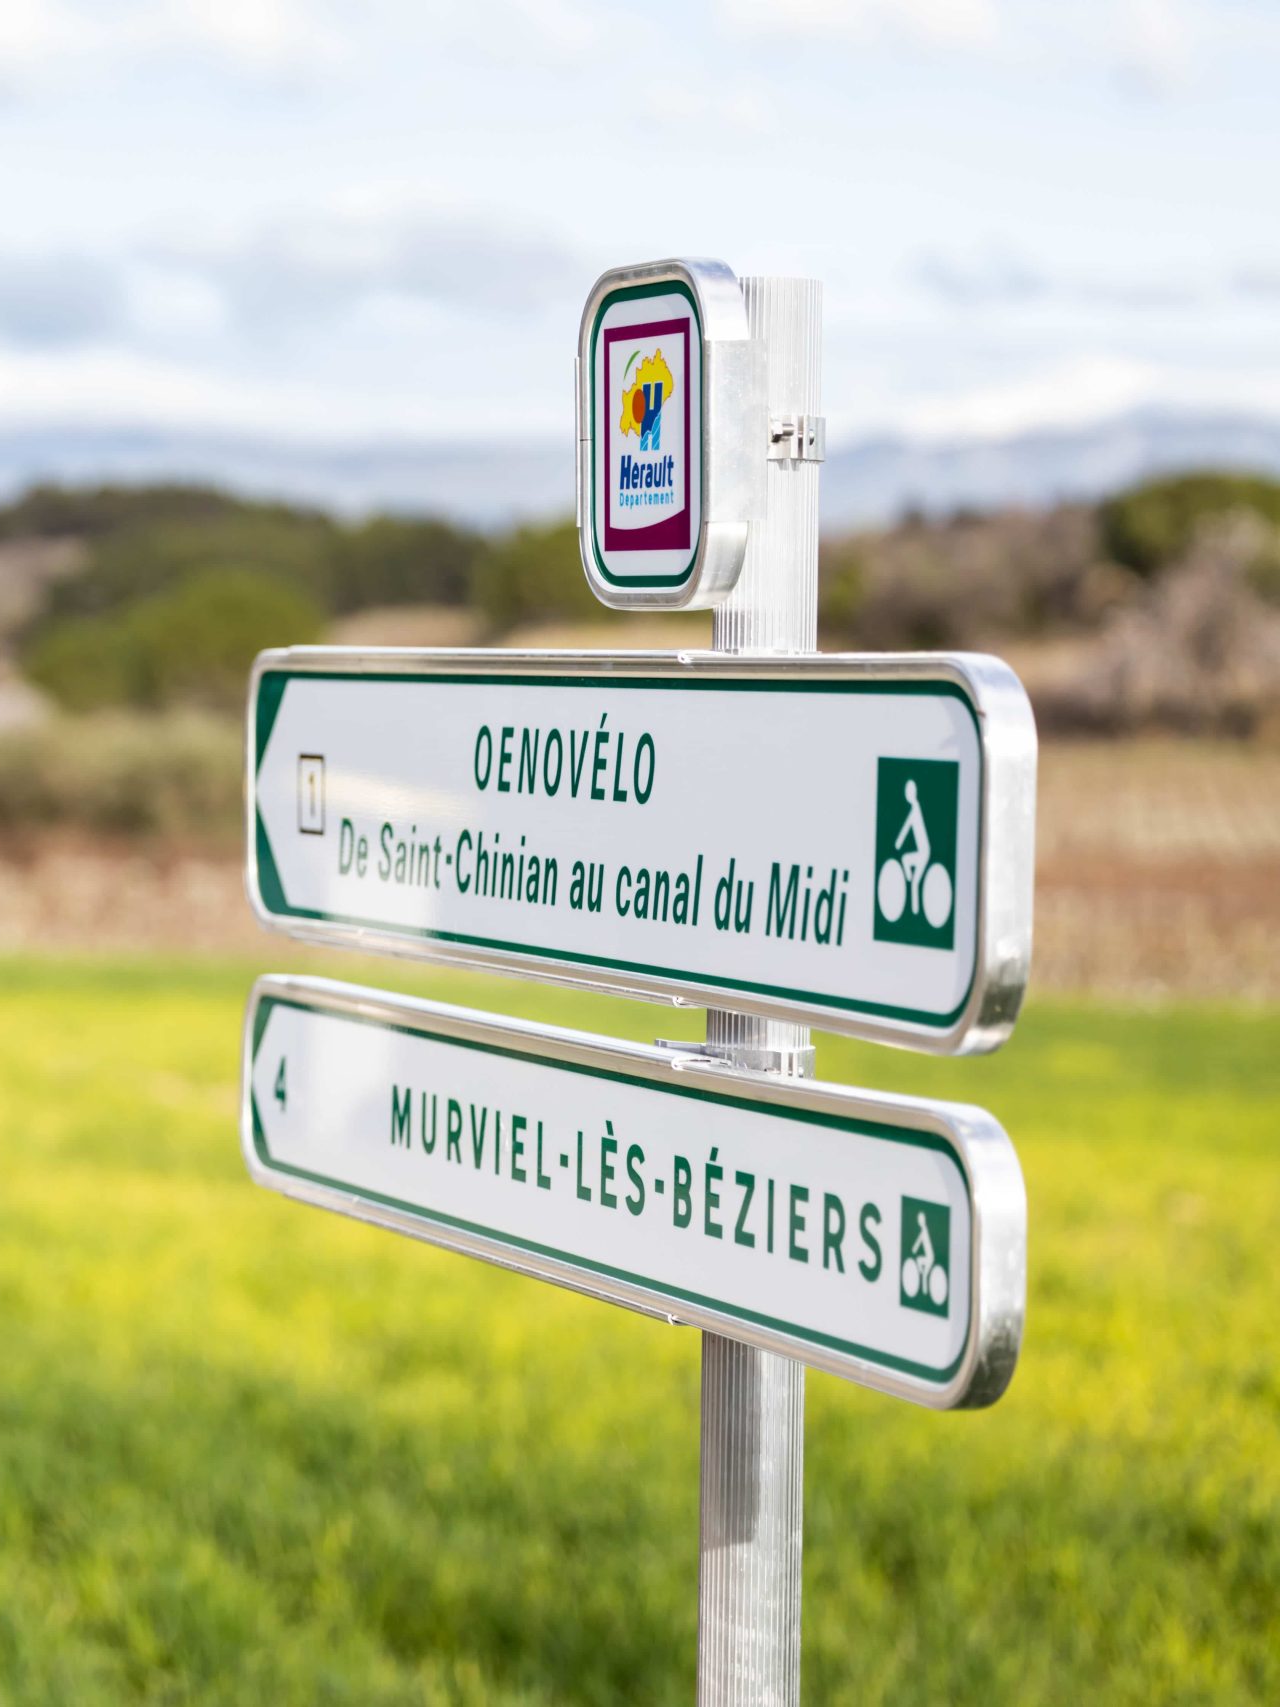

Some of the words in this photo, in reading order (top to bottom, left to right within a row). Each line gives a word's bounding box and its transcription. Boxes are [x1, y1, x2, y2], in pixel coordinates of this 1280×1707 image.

[308, 771, 317, 818] 1
[474, 712, 656, 805] OENOVÉLO
[338, 817, 369, 879] De
[377, 821, 558, 907] Saint-Chinian
[569, 860, 605, 913] au
[615, 853, 704, 927] canal
[714, 857, 755, 934] du
[764, 861, 850, 947] Midi
[274, 1054, 287, 1114] 4
[391, 1084, 883, 1283] MURVIEL-LÈS-BÉZIERS
